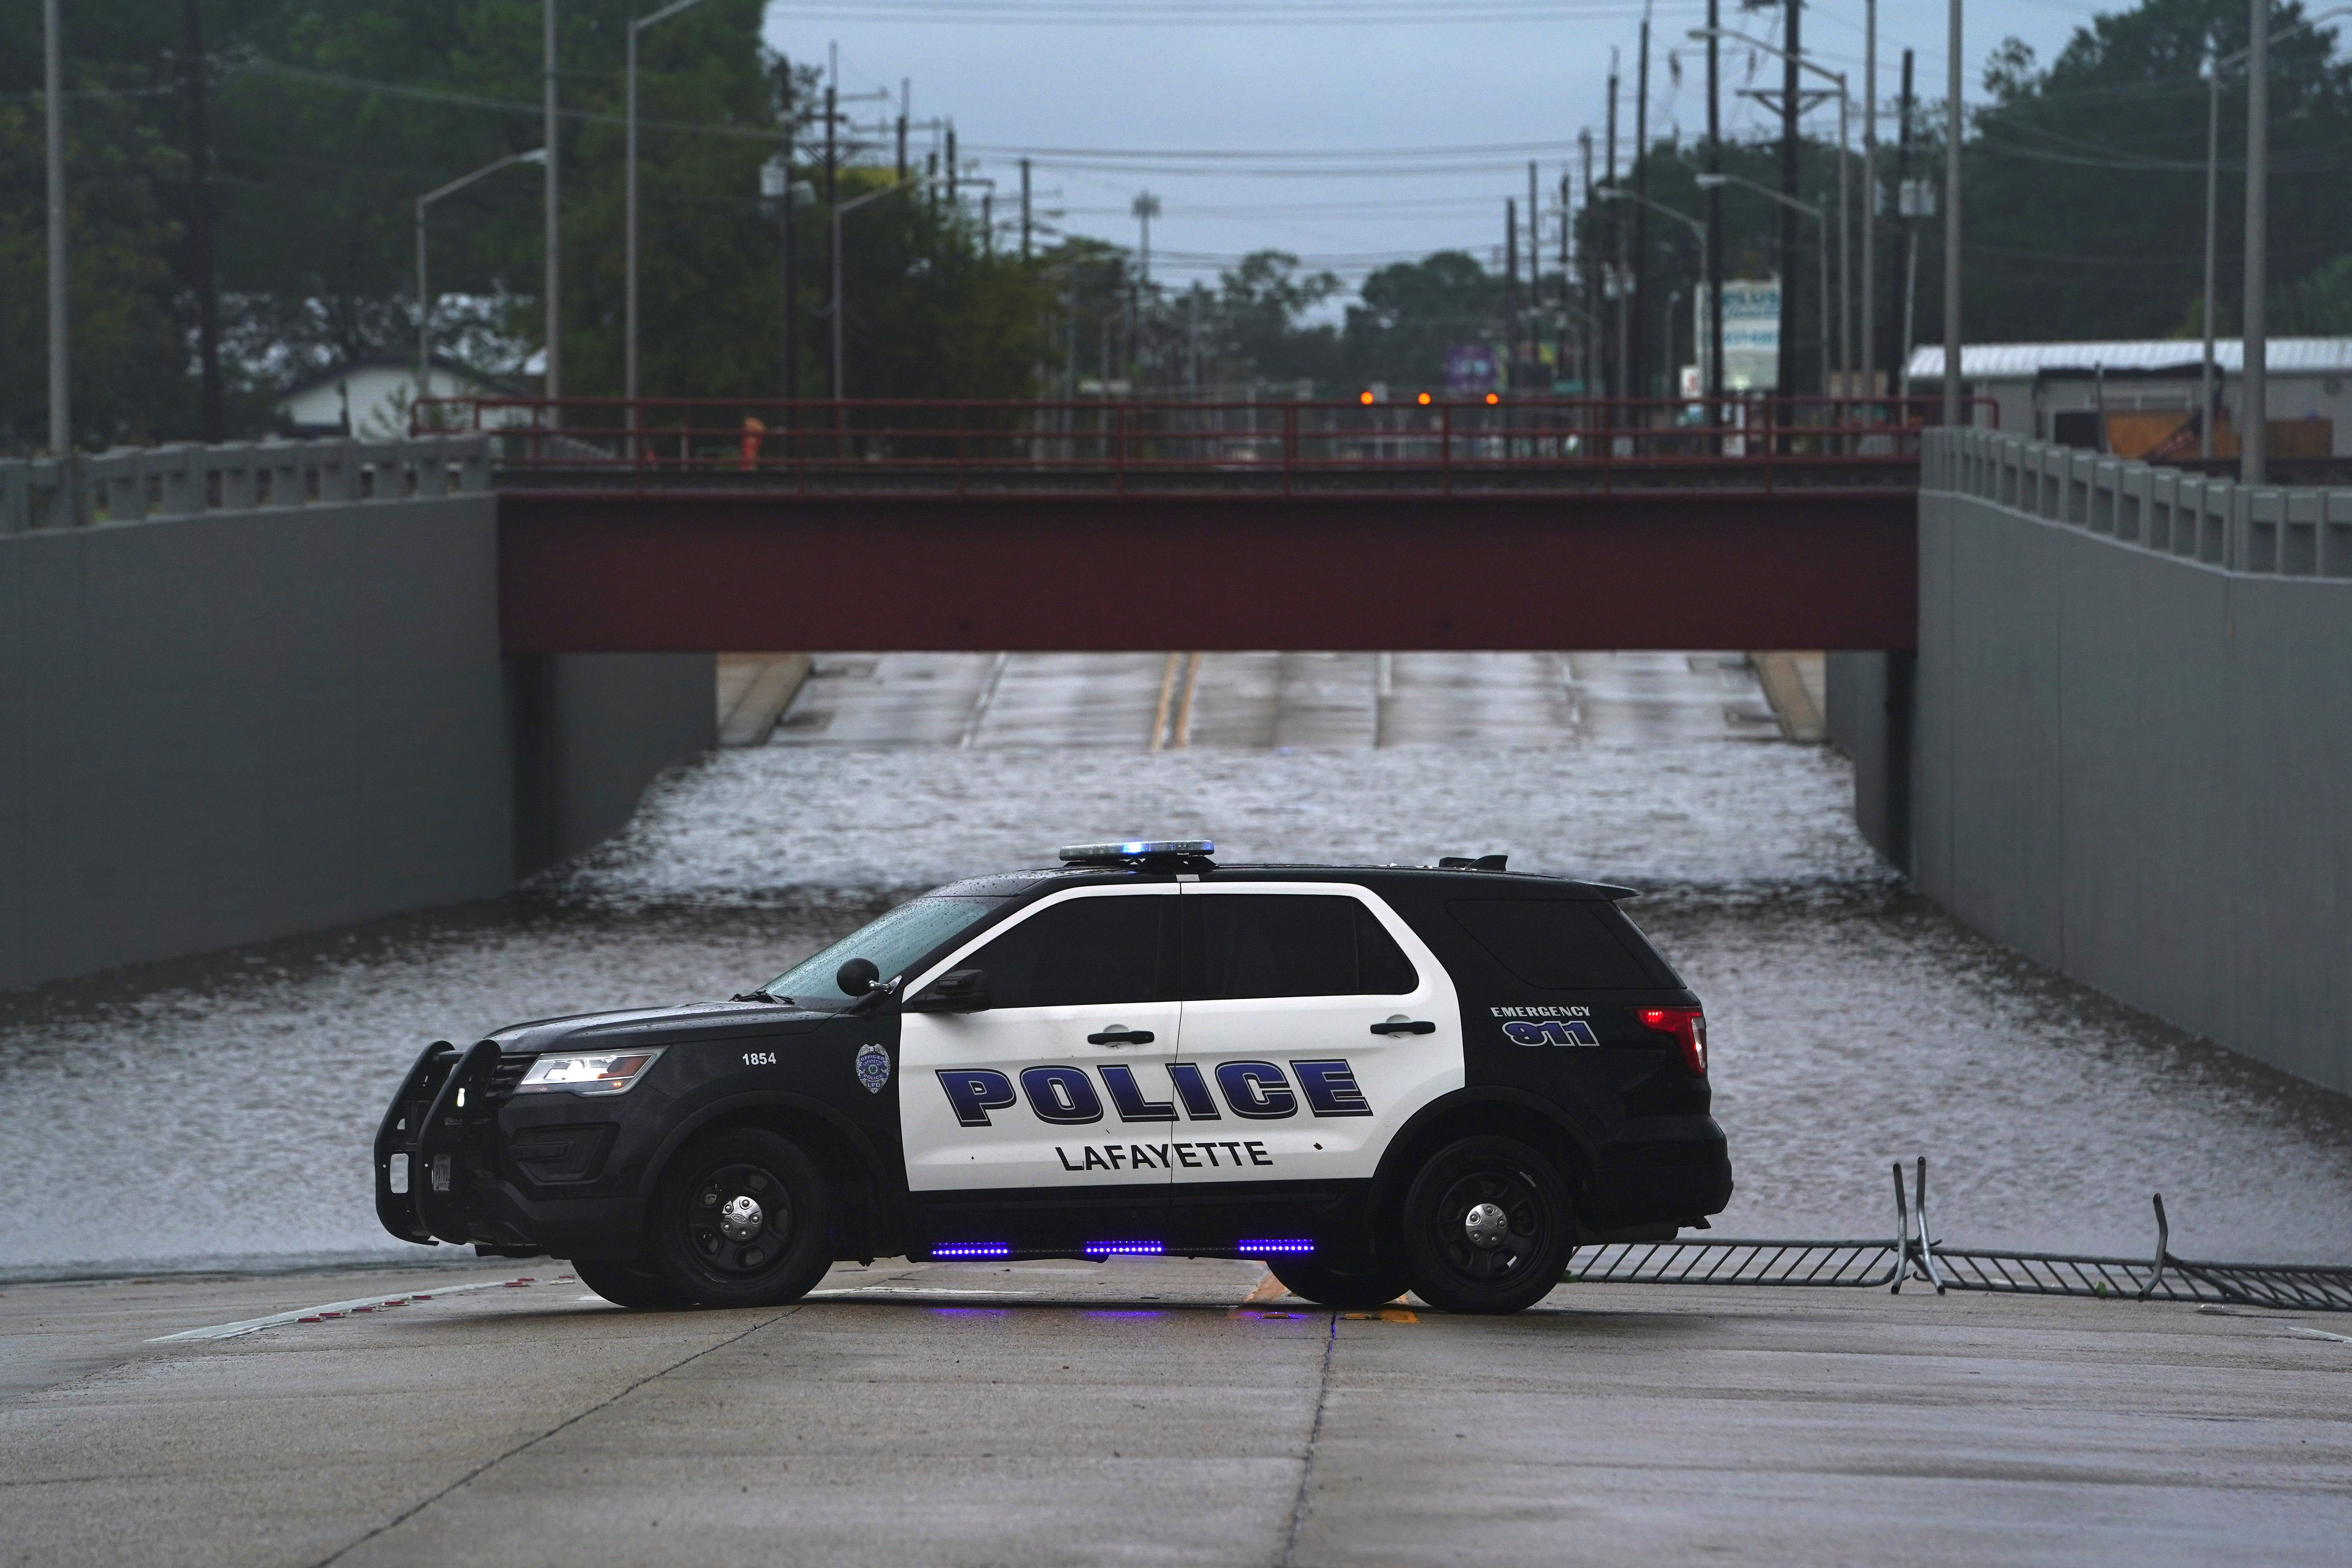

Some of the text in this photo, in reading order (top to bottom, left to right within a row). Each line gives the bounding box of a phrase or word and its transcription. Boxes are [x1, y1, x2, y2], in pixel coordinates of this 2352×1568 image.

[1490, 1006, 1591, 1017] EMERGENCY
[1502, 1021, 1600, 1046] 911
[742, 1052, 777, 1066] 1854
[934, 1058, 1374, 1127] POLICE
[1055, 1141, 1273, 1171] LAFAYETTE
